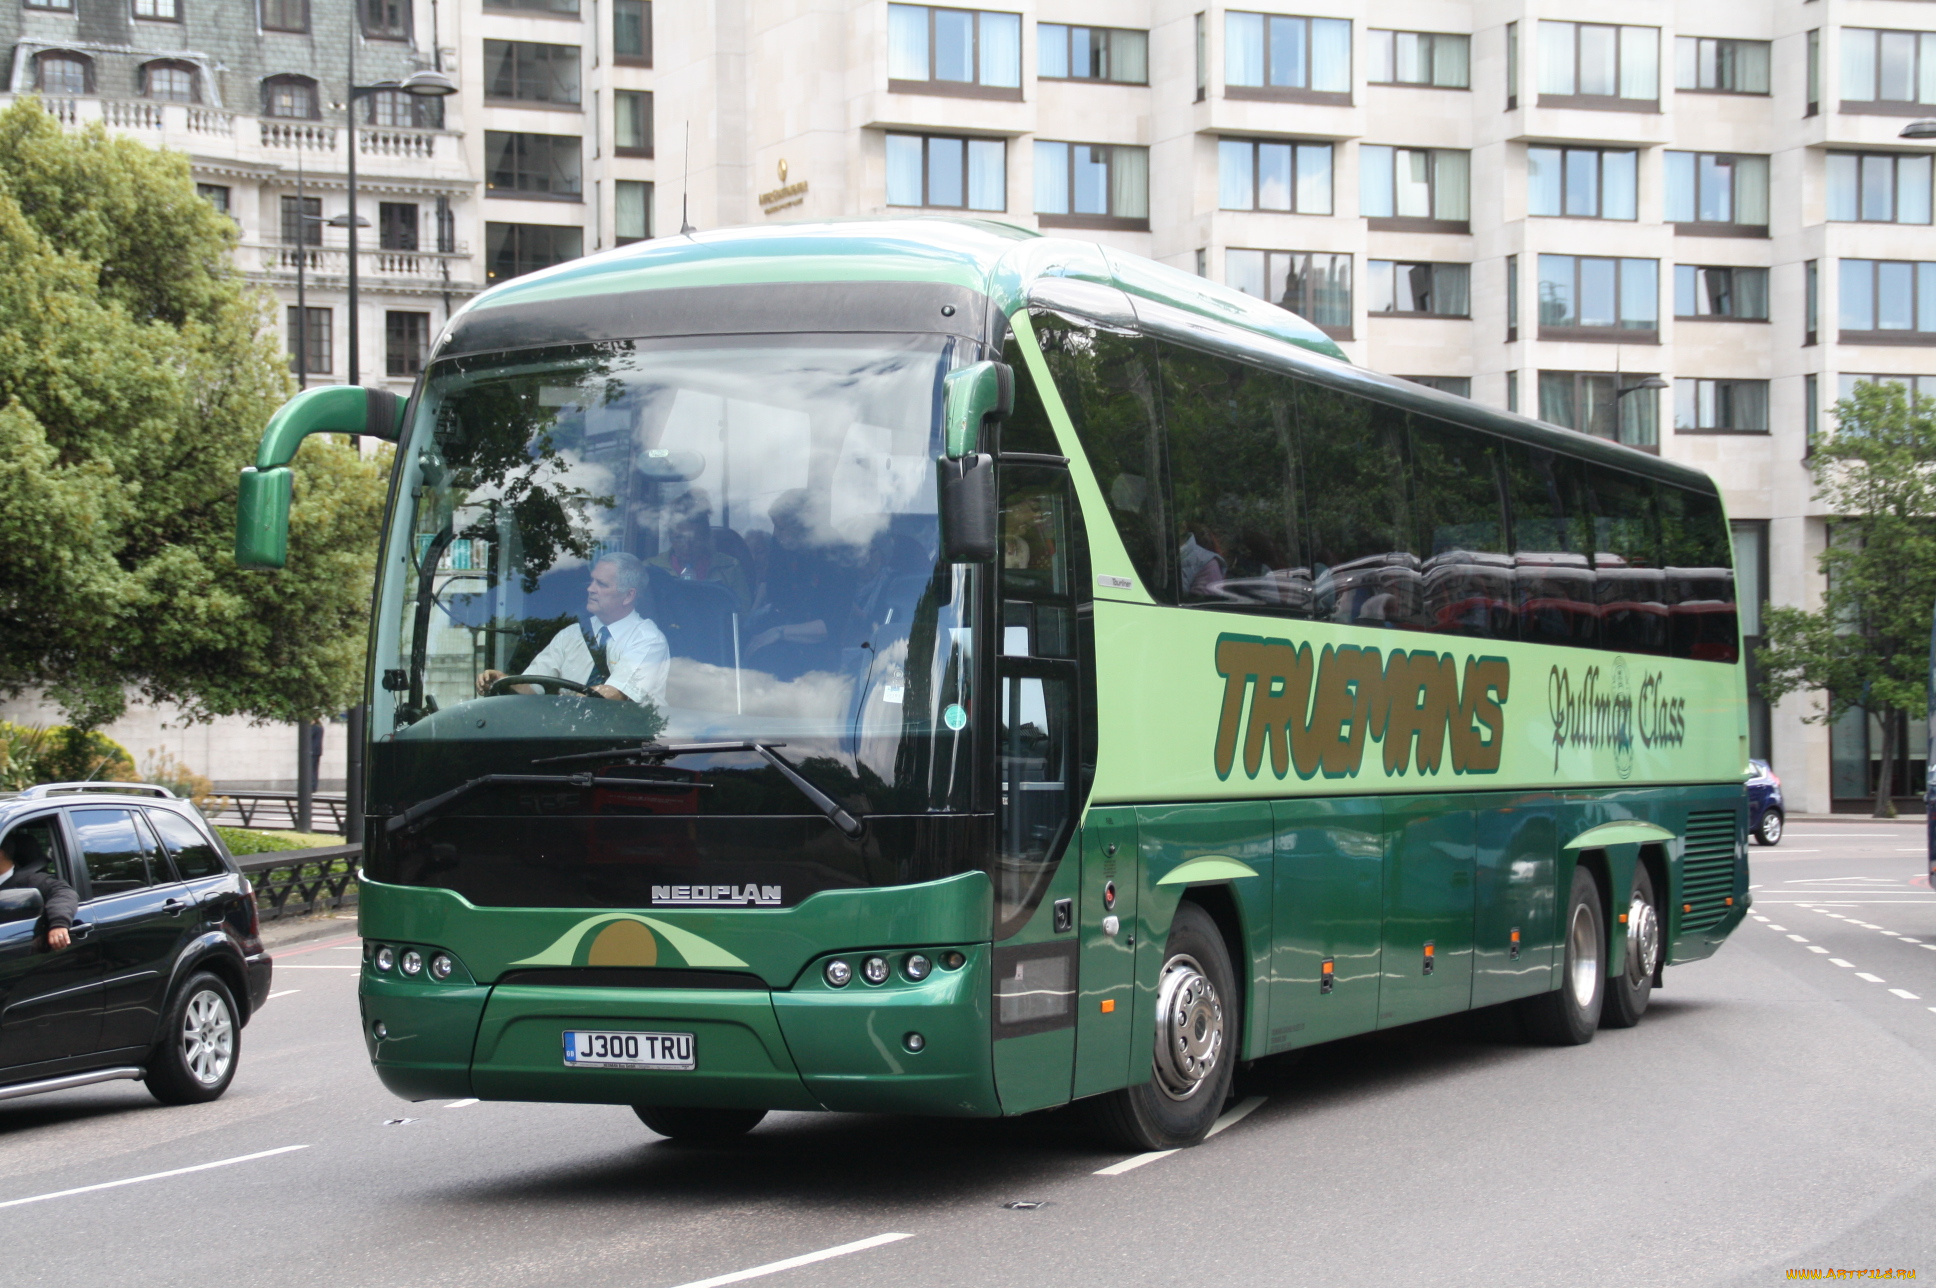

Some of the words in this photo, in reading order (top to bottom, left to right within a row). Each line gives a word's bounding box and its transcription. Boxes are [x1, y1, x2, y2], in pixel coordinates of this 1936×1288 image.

[1214, 631, 1510, 782] TRUEMANS
[1549, 664, 1633, 776] Pullman
[1638, 669, 1685, 749] Class
[651, 883, 782, 904] NEOPLAN
[580, 1034, 639, 1059] J300
[645, 1036, 691, 1060] TRU
